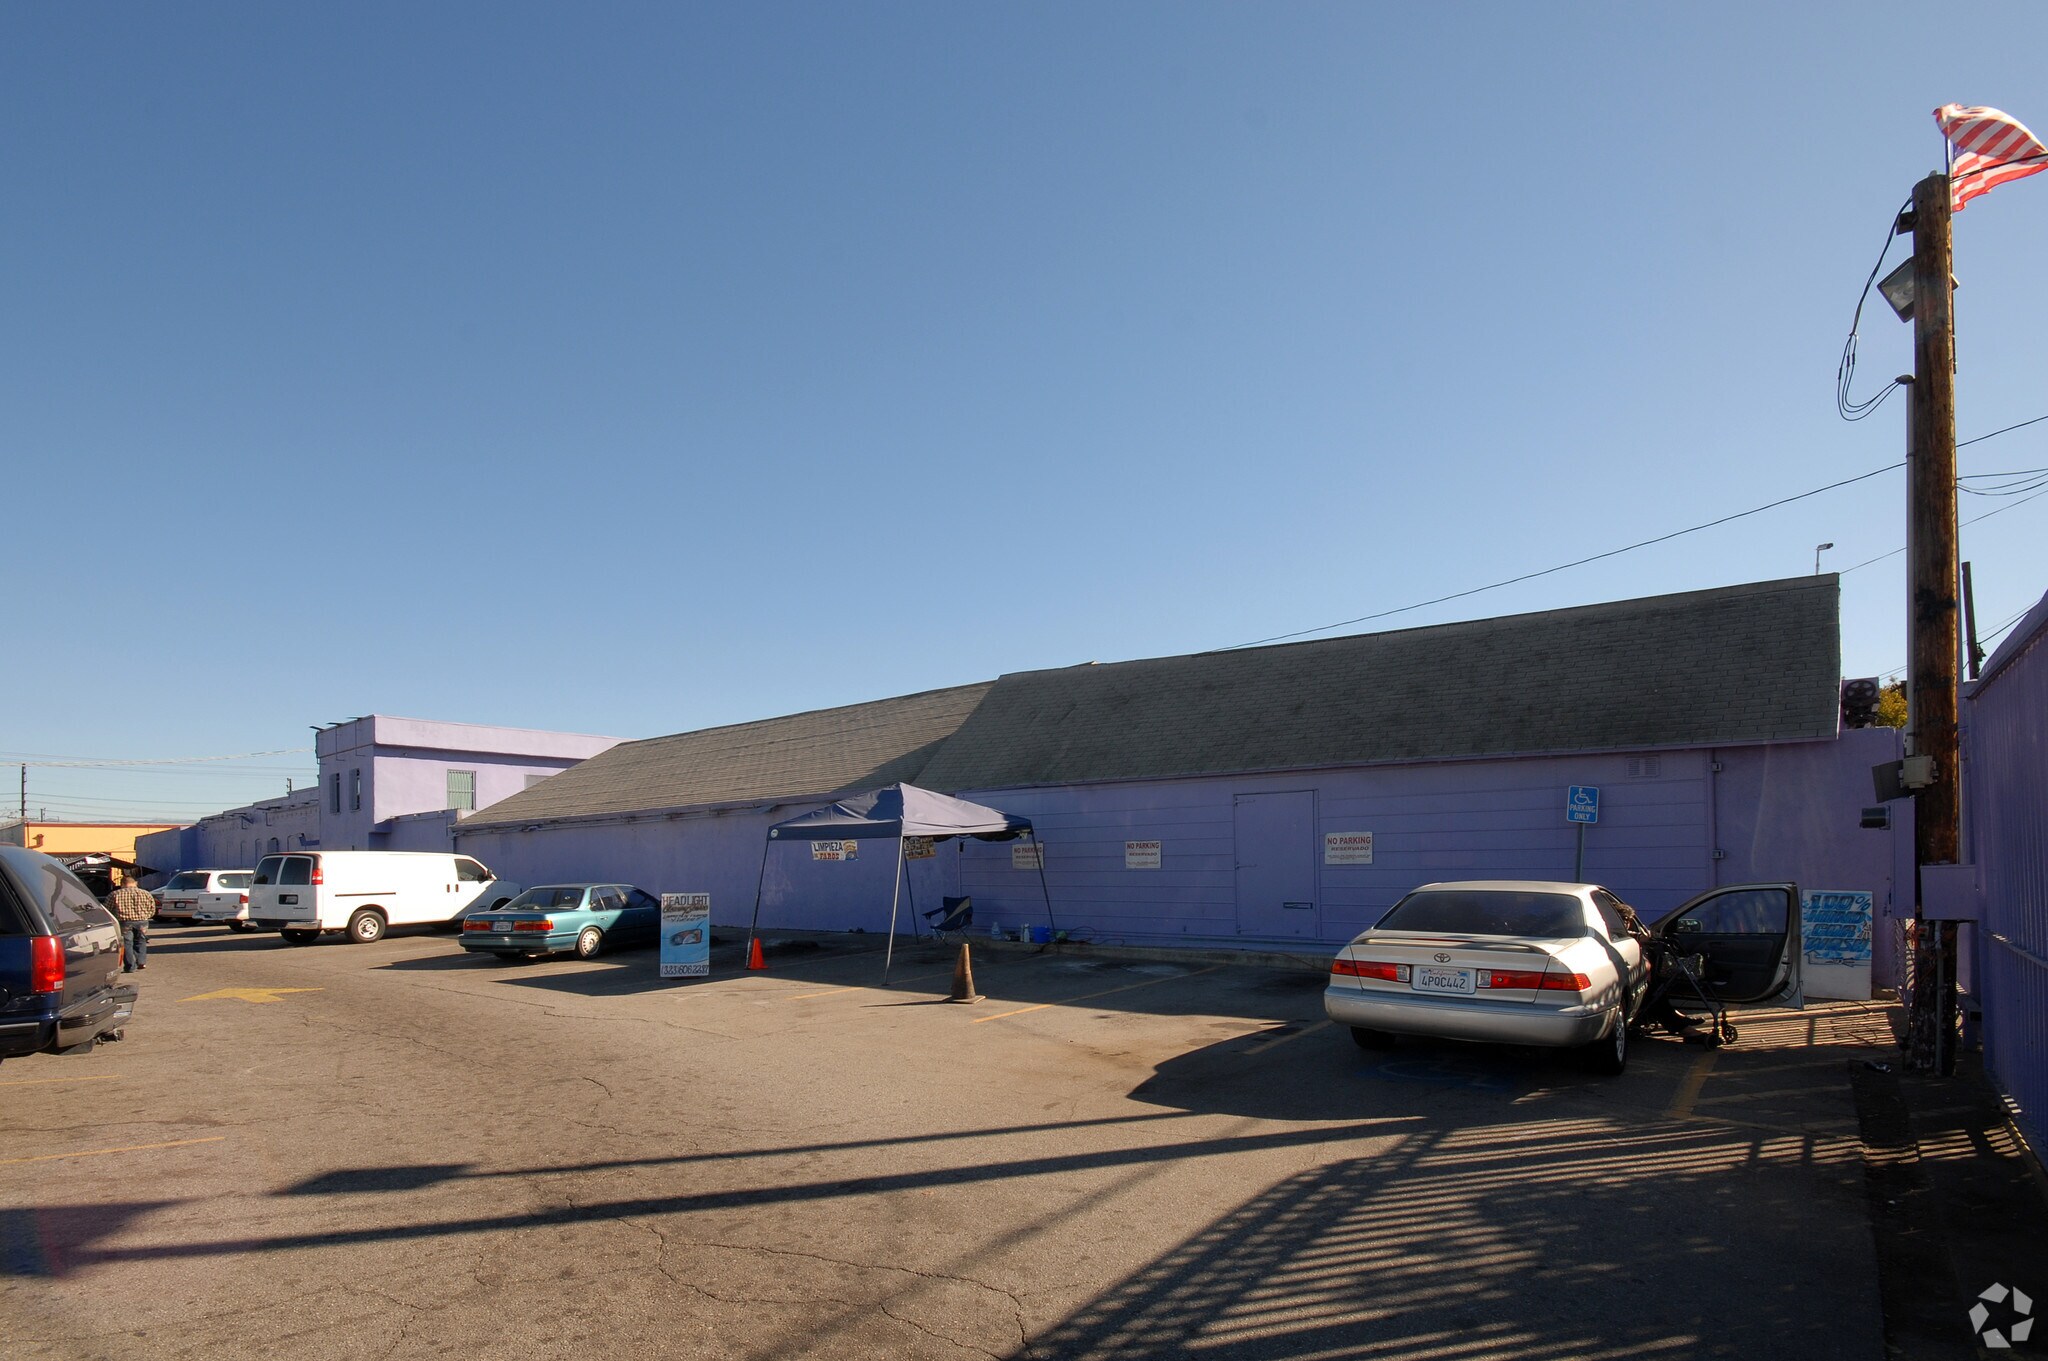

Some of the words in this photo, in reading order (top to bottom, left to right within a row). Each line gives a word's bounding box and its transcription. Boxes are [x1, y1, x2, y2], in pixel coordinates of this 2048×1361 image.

[1570, 803, 1596, 813] PARKING
[1574, 812, 1591, 820] ONLY
[1327, 837, 1338, 845] NO
[1339, 836, 1371, 844] PARKING
[812, 841, 844, 852] LIMPIEZA
[662, 895, 708, 906] HEADLIGHT
[1809, 895, 1871, 911] 100%
[1421, 975, 1466, 989] 4PQC442
